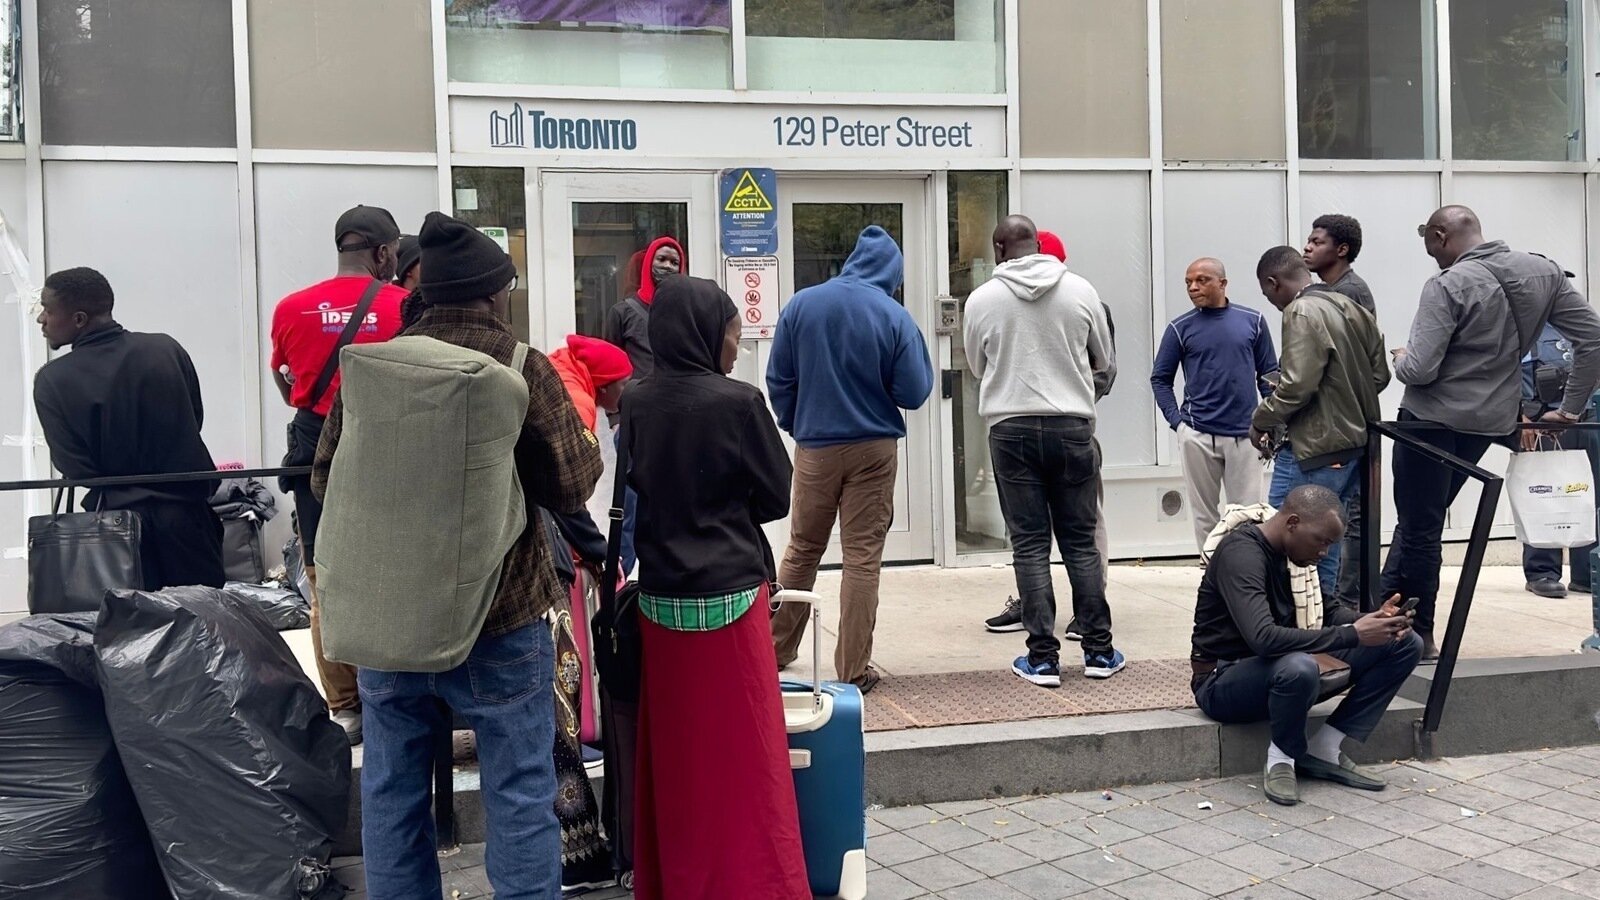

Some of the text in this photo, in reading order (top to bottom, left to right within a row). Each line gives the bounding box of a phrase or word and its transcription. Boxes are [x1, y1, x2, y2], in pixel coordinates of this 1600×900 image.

[528, 110, 637, 150] TORONTO
[773, 116, 972, 147] 129 Peter Street
[733, 198, 762, 208] CCTV
[321, 311, 378, 324] IDES
